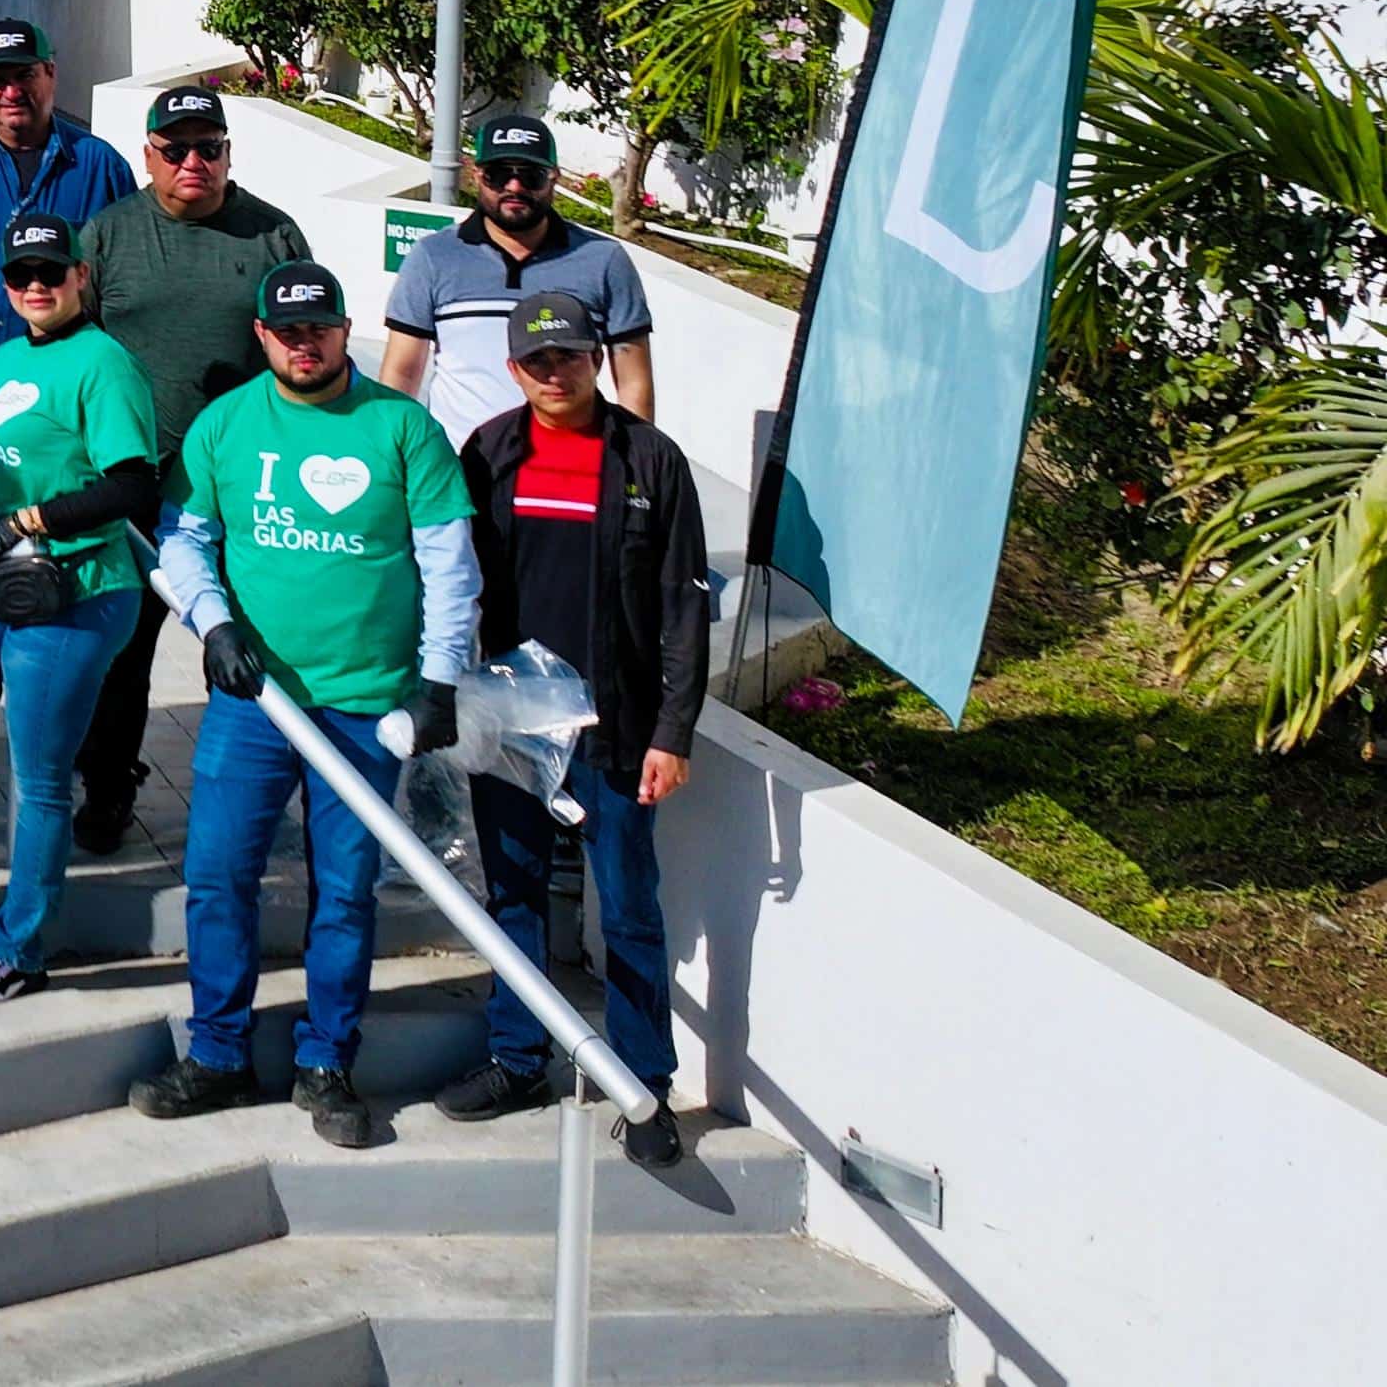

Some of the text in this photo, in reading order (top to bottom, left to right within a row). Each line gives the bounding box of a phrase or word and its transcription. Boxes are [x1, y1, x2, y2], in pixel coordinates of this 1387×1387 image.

[387, 223, 405, 239] NO
[253, 451, 281, 502] I
[252, 504, 296, 527] LAS
[253, 525, 365, 555] GLORIAS
